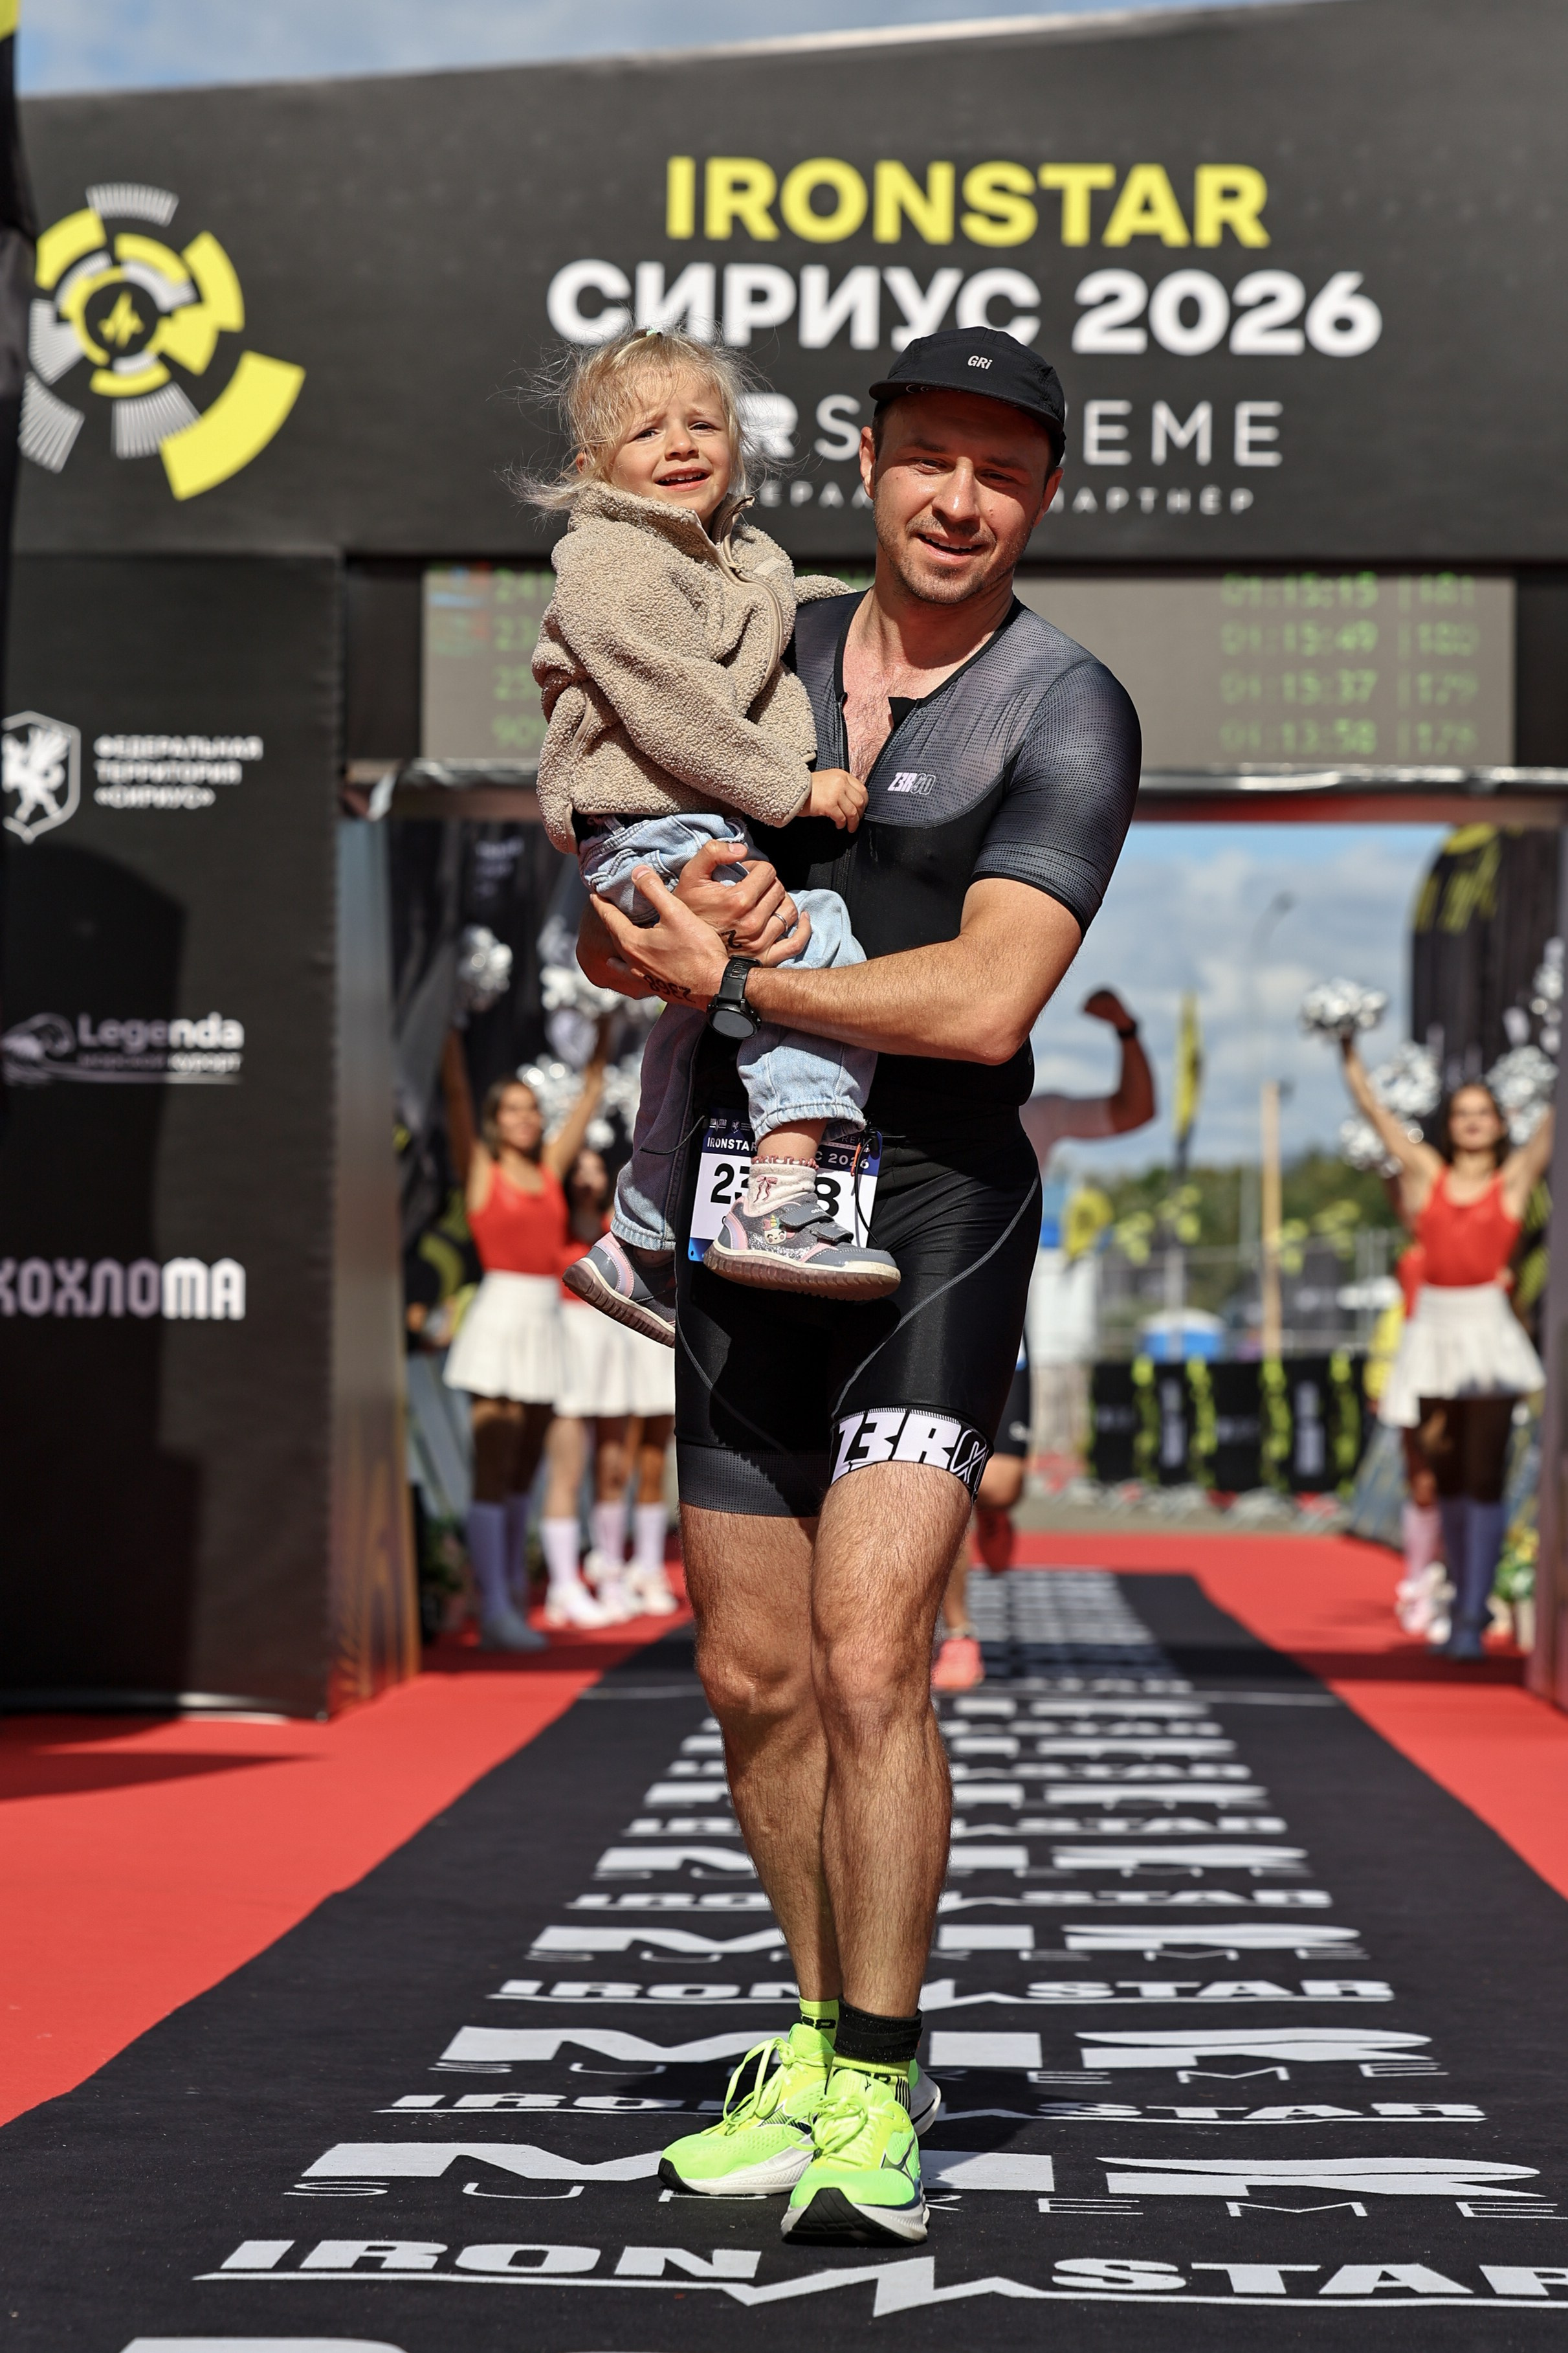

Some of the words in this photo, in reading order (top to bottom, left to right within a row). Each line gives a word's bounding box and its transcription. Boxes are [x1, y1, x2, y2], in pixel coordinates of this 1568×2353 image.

[667, 156, 1270, 249] IRONSTAR
[546, 260, 1041, 351] СИРИУС
[1071, 269, 1382, 357] 2026
[77, 1012, 245, 1054] Legenda
[707, 1137, 758, 1152] IRONSTAR
[1037, 2102, 1488, 2119] STAR
[220, 2239, 761, 2279] IRON
